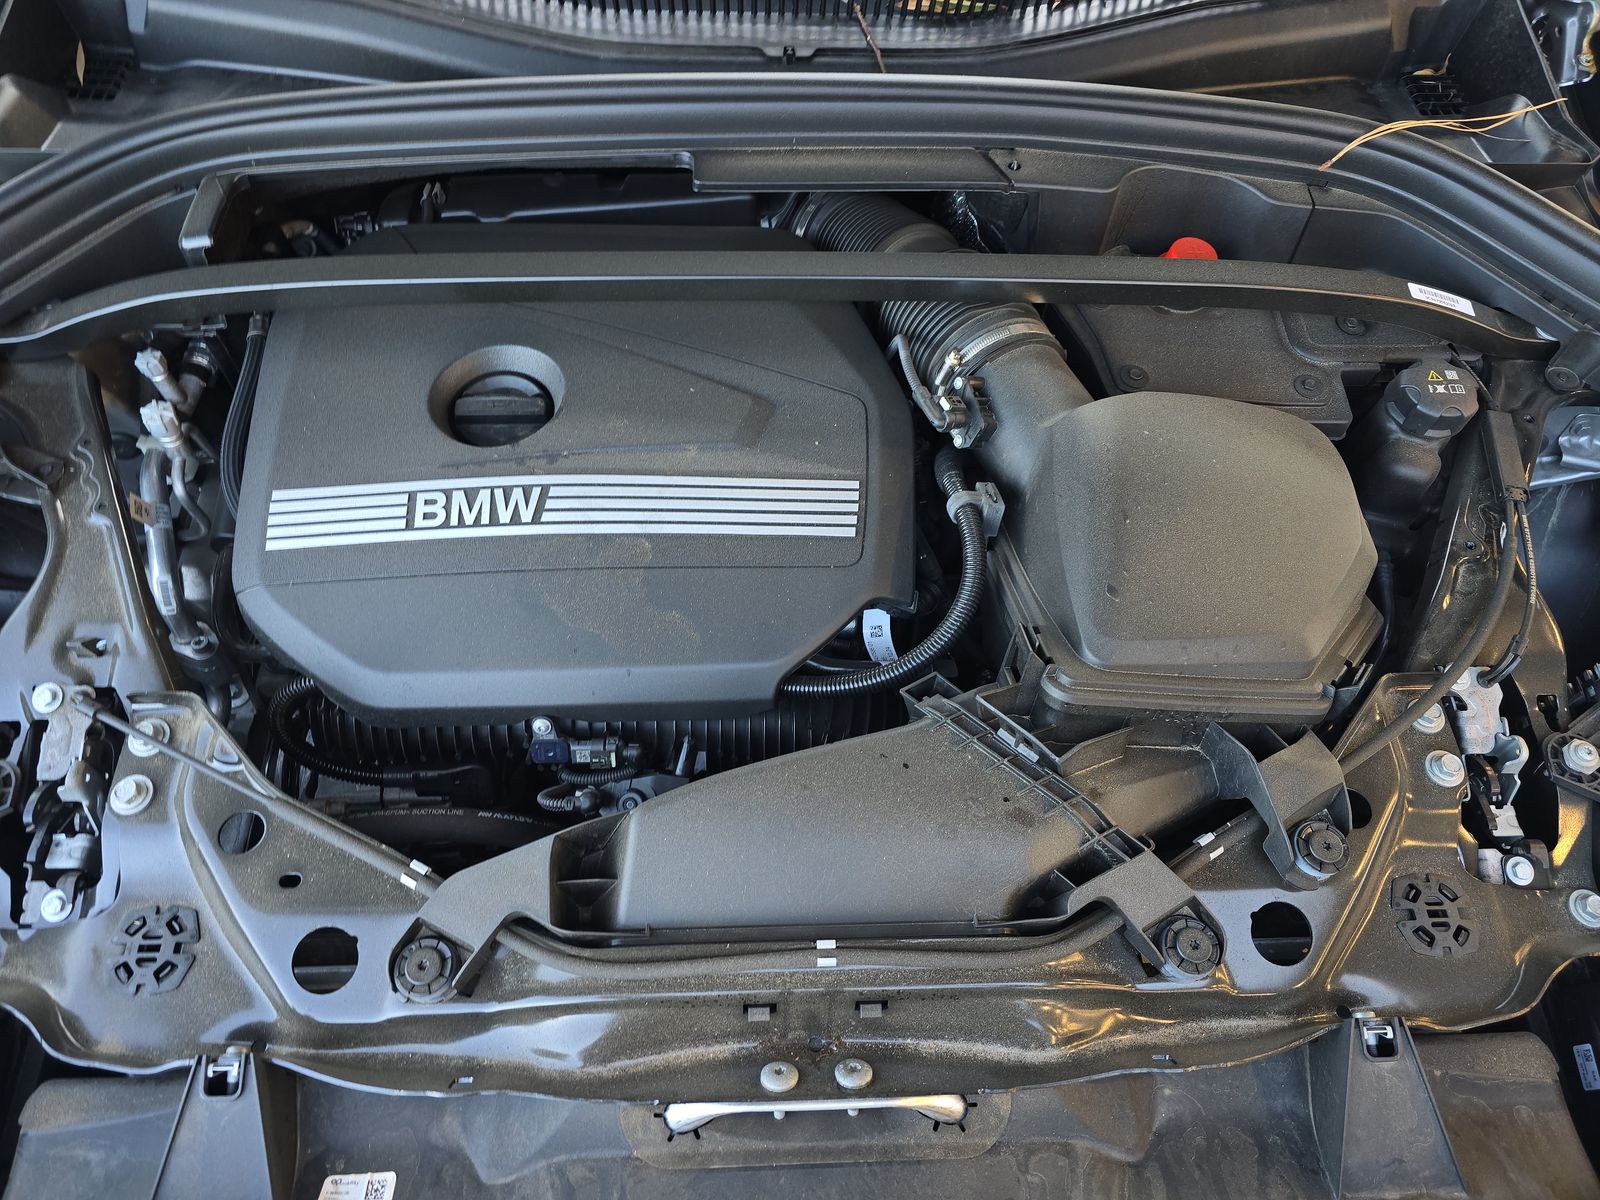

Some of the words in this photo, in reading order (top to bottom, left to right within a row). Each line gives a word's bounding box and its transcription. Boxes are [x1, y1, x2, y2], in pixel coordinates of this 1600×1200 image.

[413, 486, 542, 528] BMW
[411, 807, 446, 816] SUCTION
[446, 808, 464, 816] LINE
